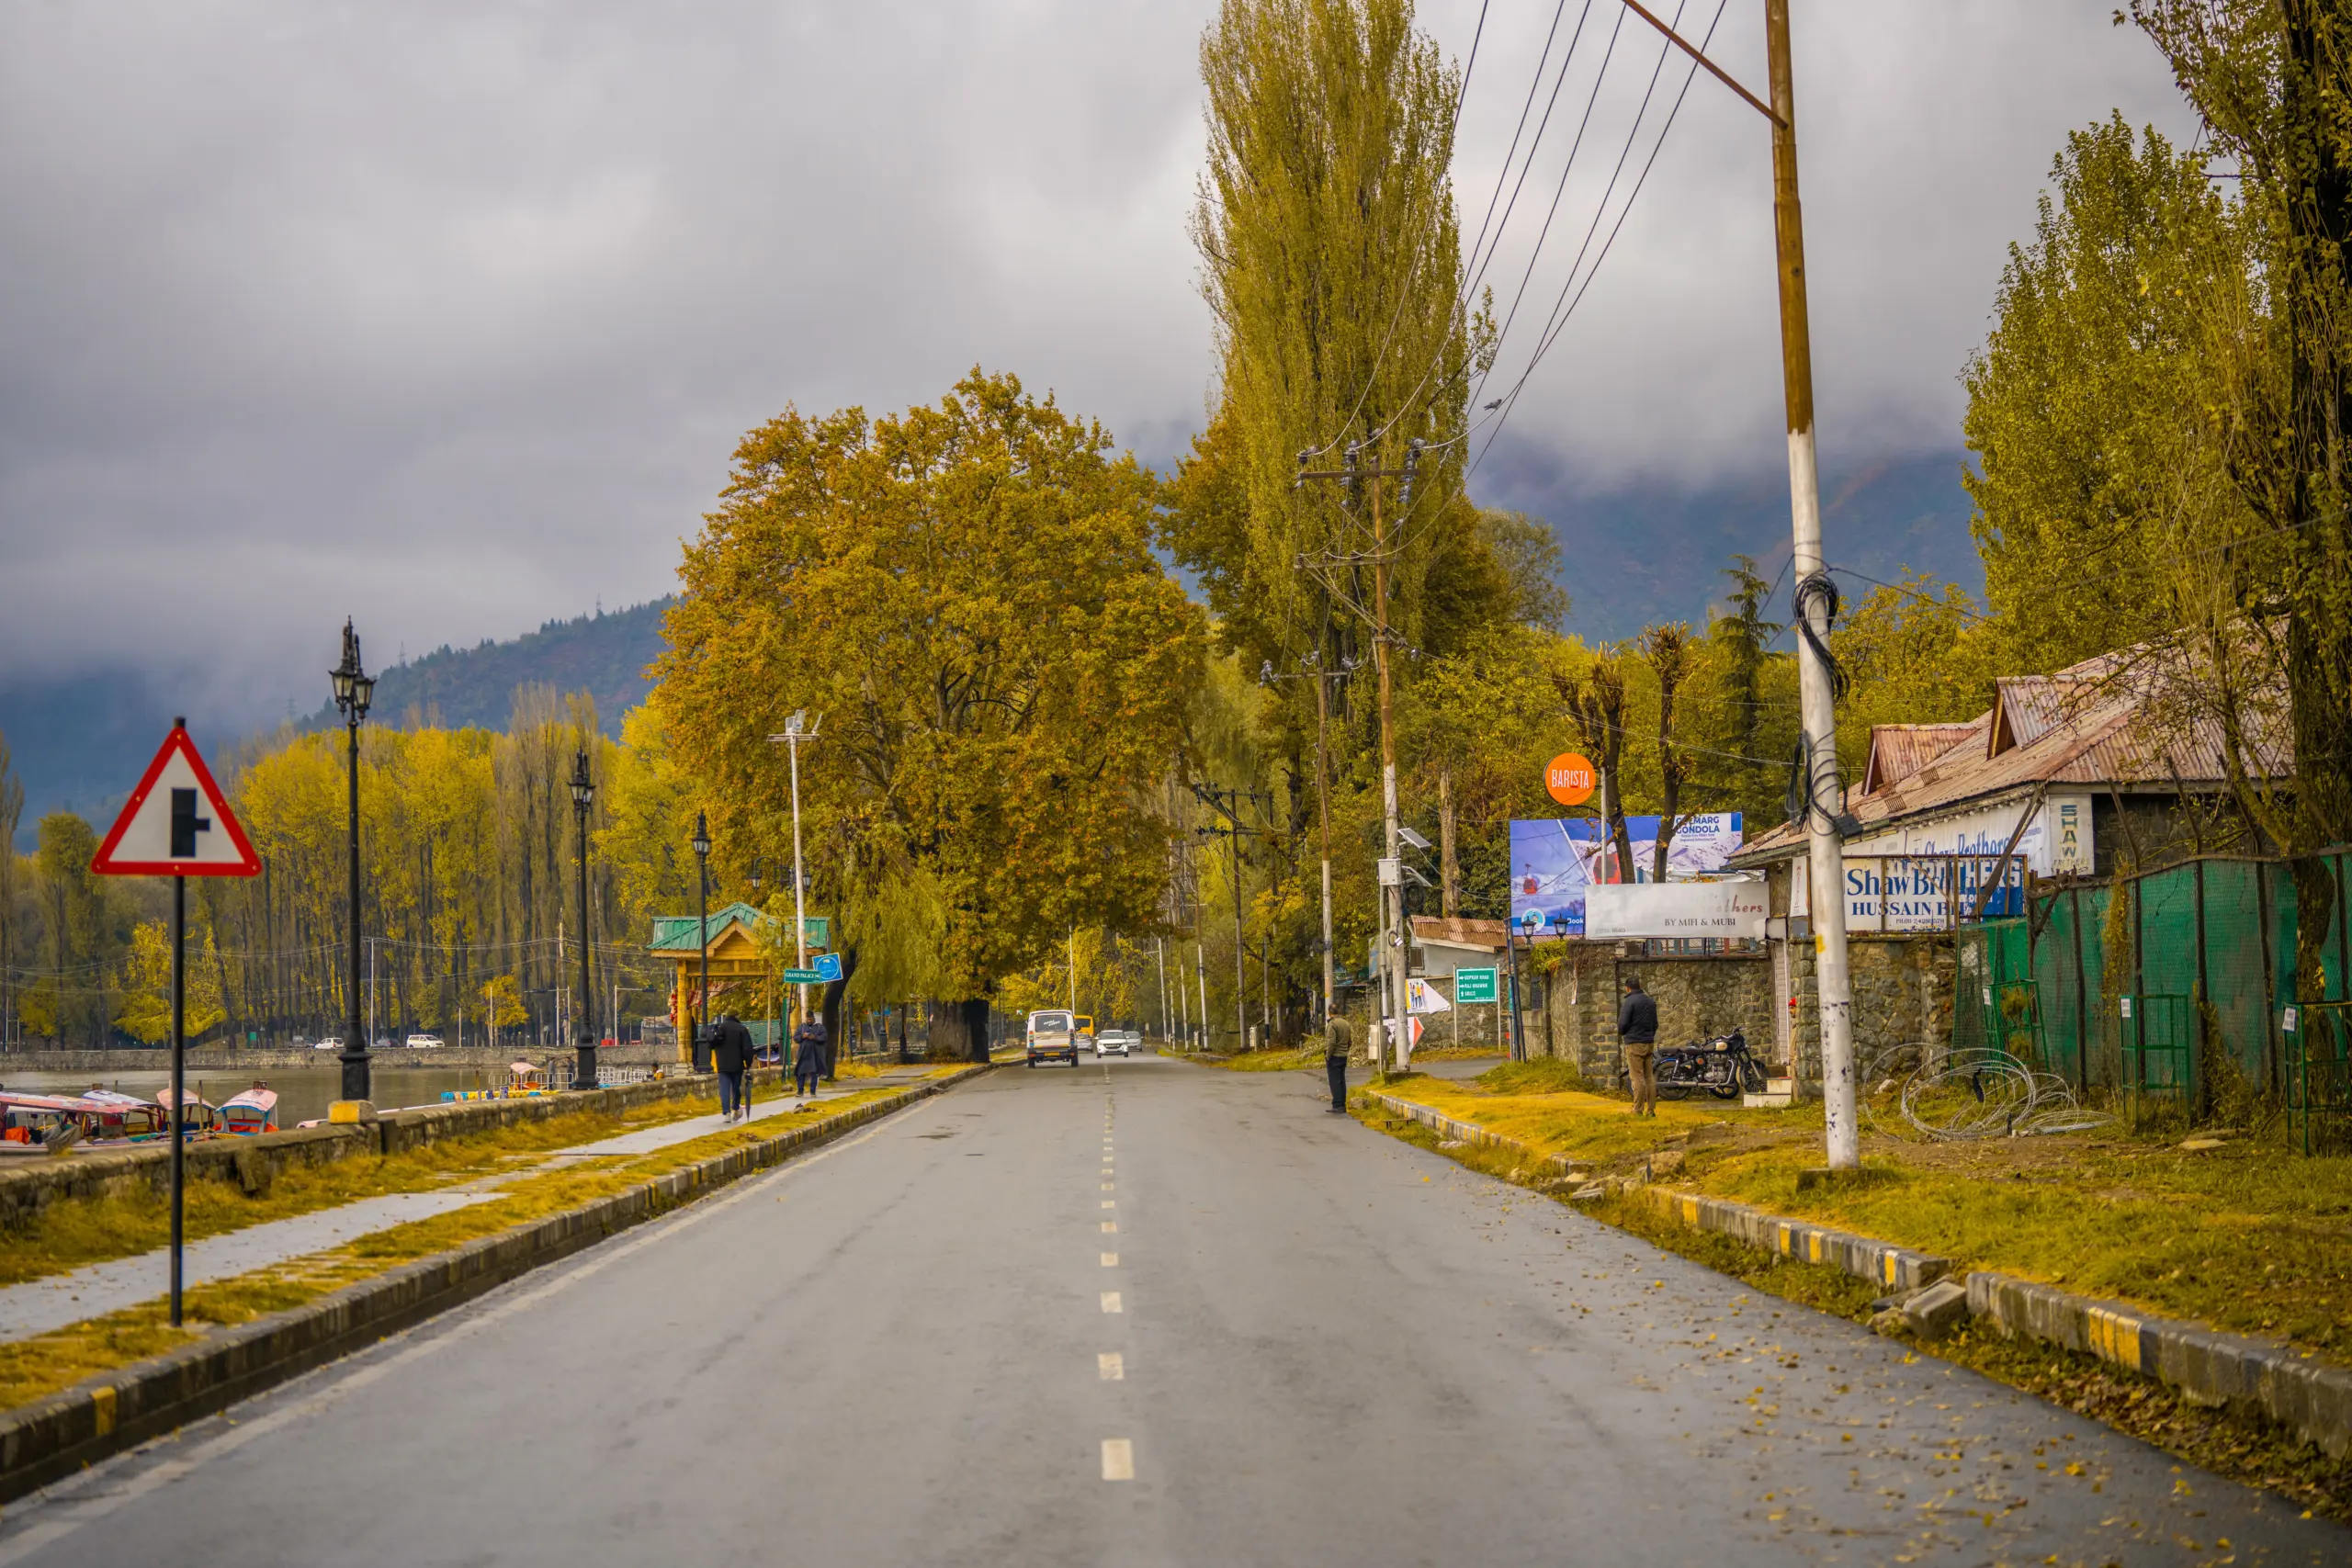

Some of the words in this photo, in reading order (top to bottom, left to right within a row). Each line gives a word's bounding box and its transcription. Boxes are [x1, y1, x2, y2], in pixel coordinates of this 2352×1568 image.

[1552, 769, 1589, 789] BARISTA
[1676, 825, 1721, 834] GONDOLA
[2061, 805, 2077, 857] SHAW
[1847, 868, 1910, 896] Shaw
[1851, 902, 1932, 916] HUSSAIN
[1665, 919, 1677, 927] BY
[1712, 918, 1736, 926] MUBI
